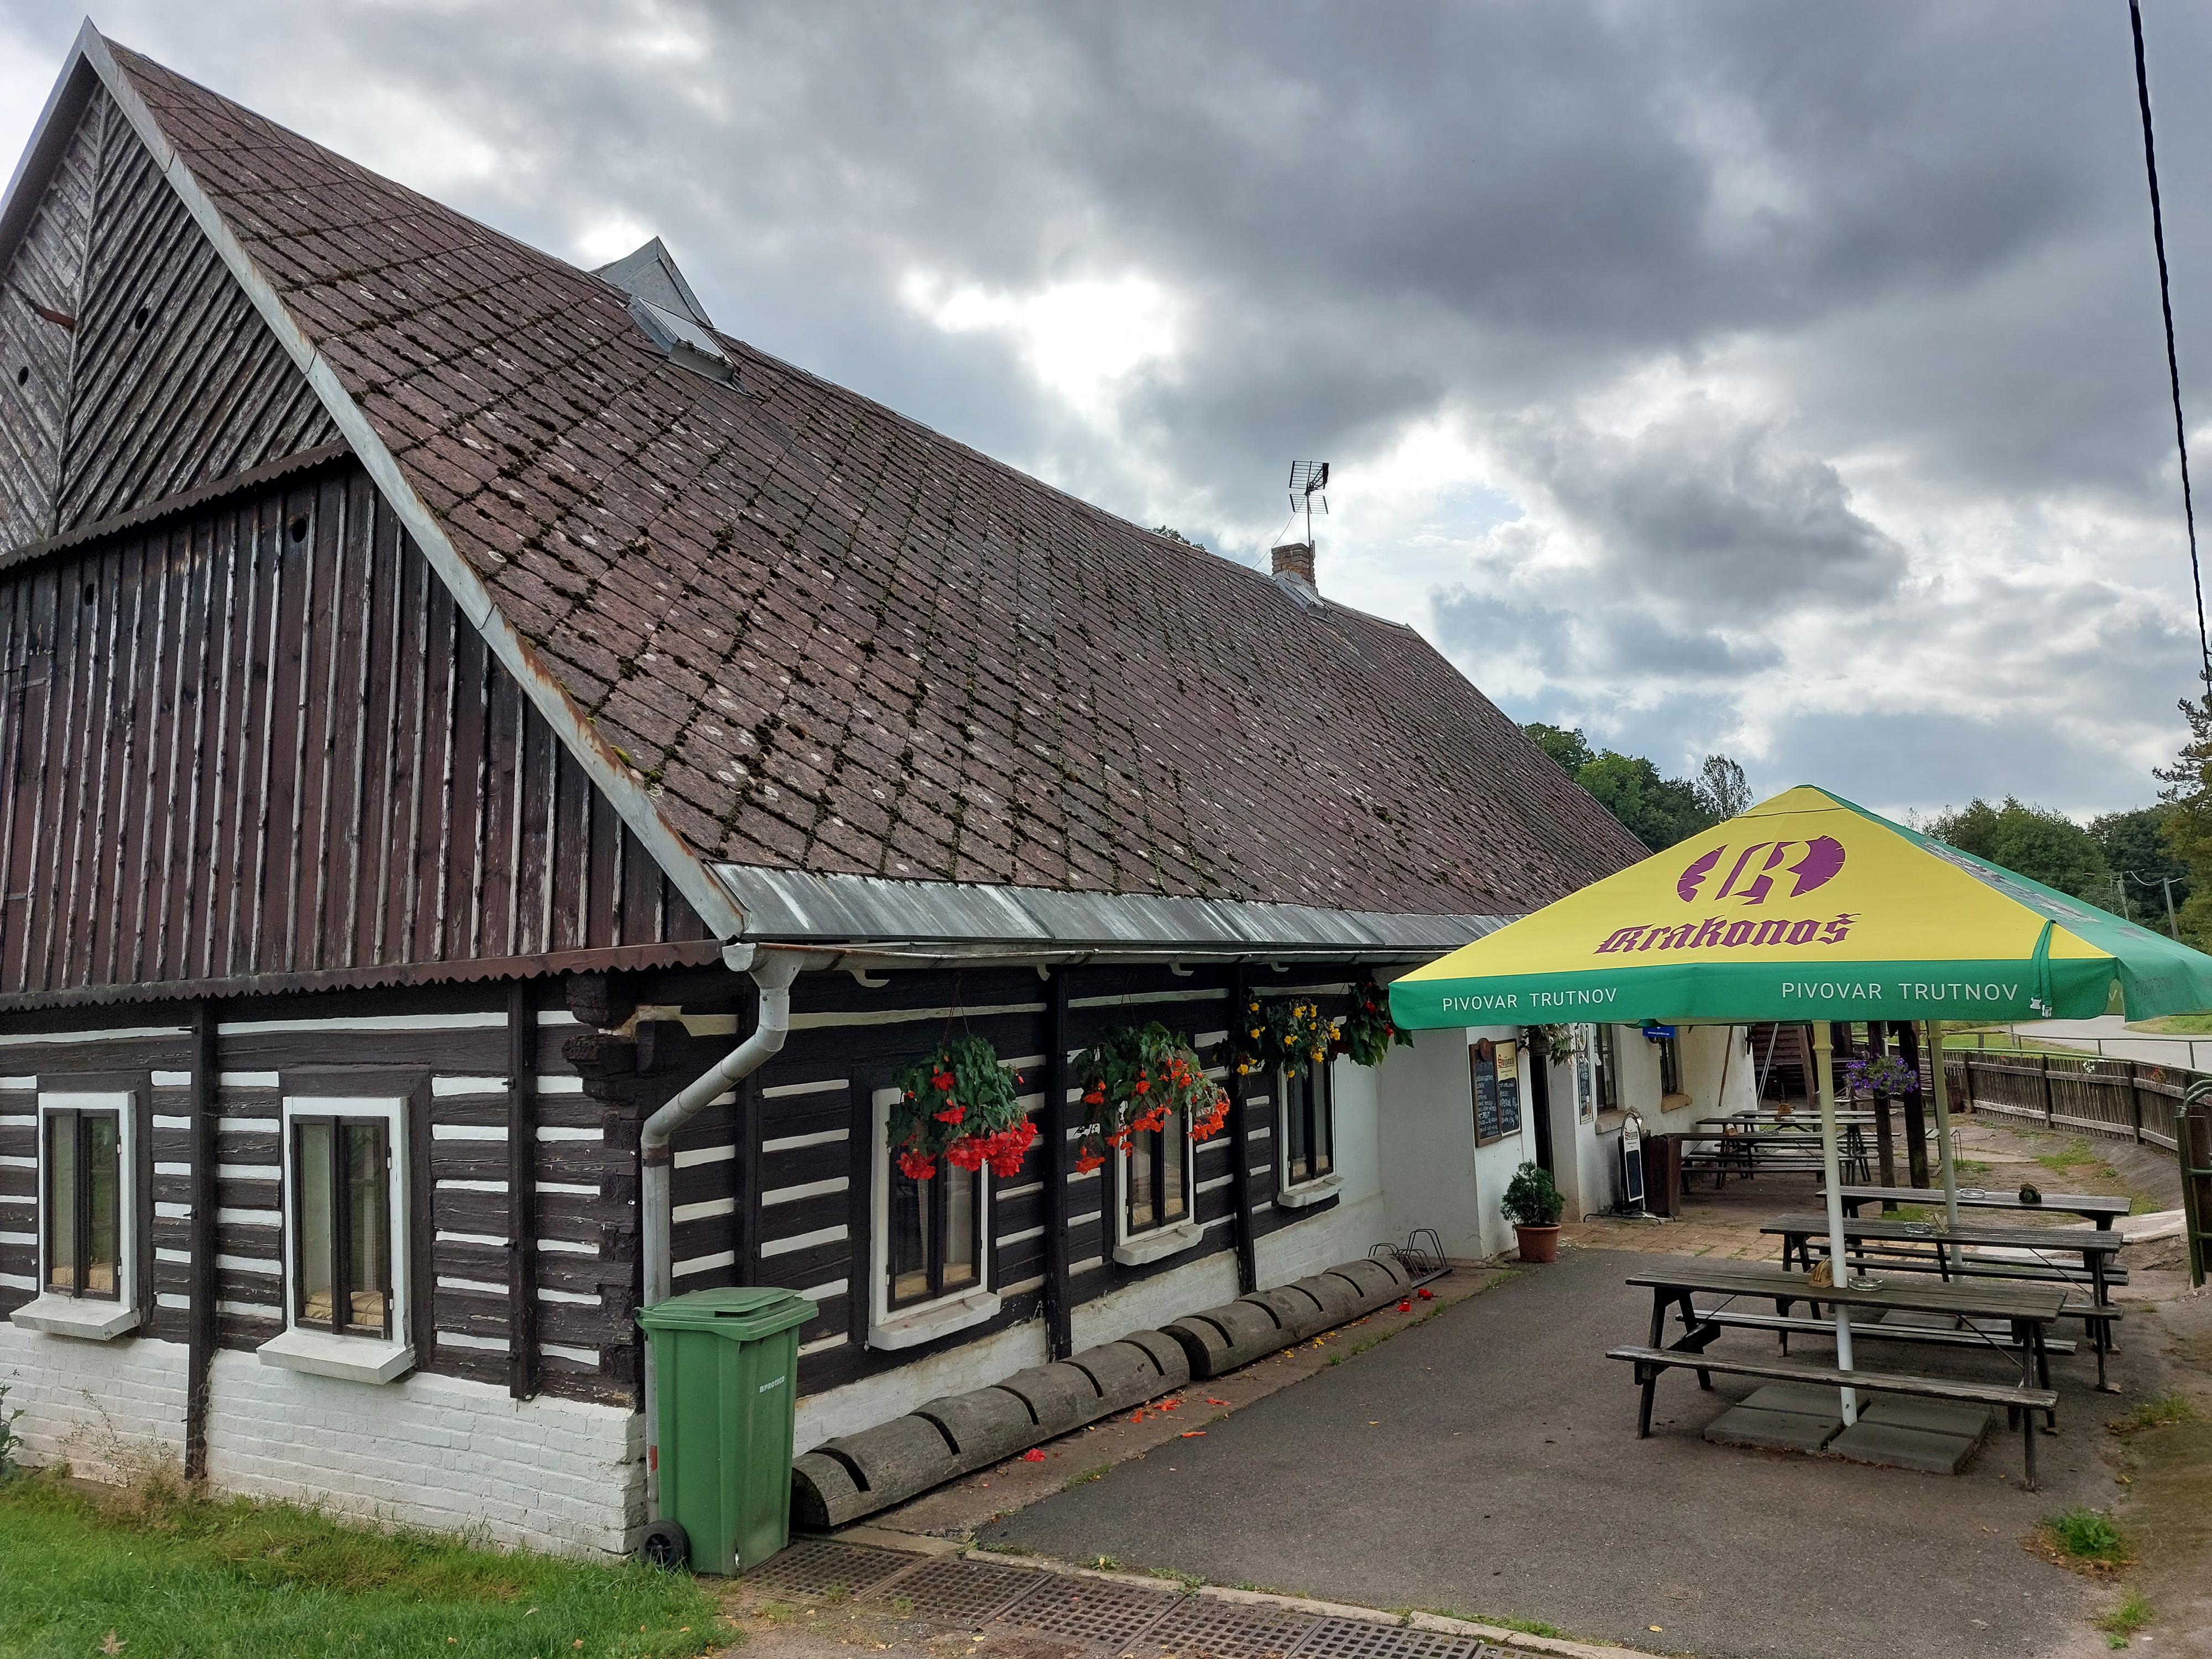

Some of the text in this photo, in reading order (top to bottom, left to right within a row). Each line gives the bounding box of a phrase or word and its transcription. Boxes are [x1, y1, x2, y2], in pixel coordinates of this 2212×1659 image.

[1592, 913, 1862, 954] Krakonoš
[1442, 988, 1618, 1012] PIVOVAR TRUTNOV
[1782, 982, 2018, 1001] PIVOVAR TRUTNOV
